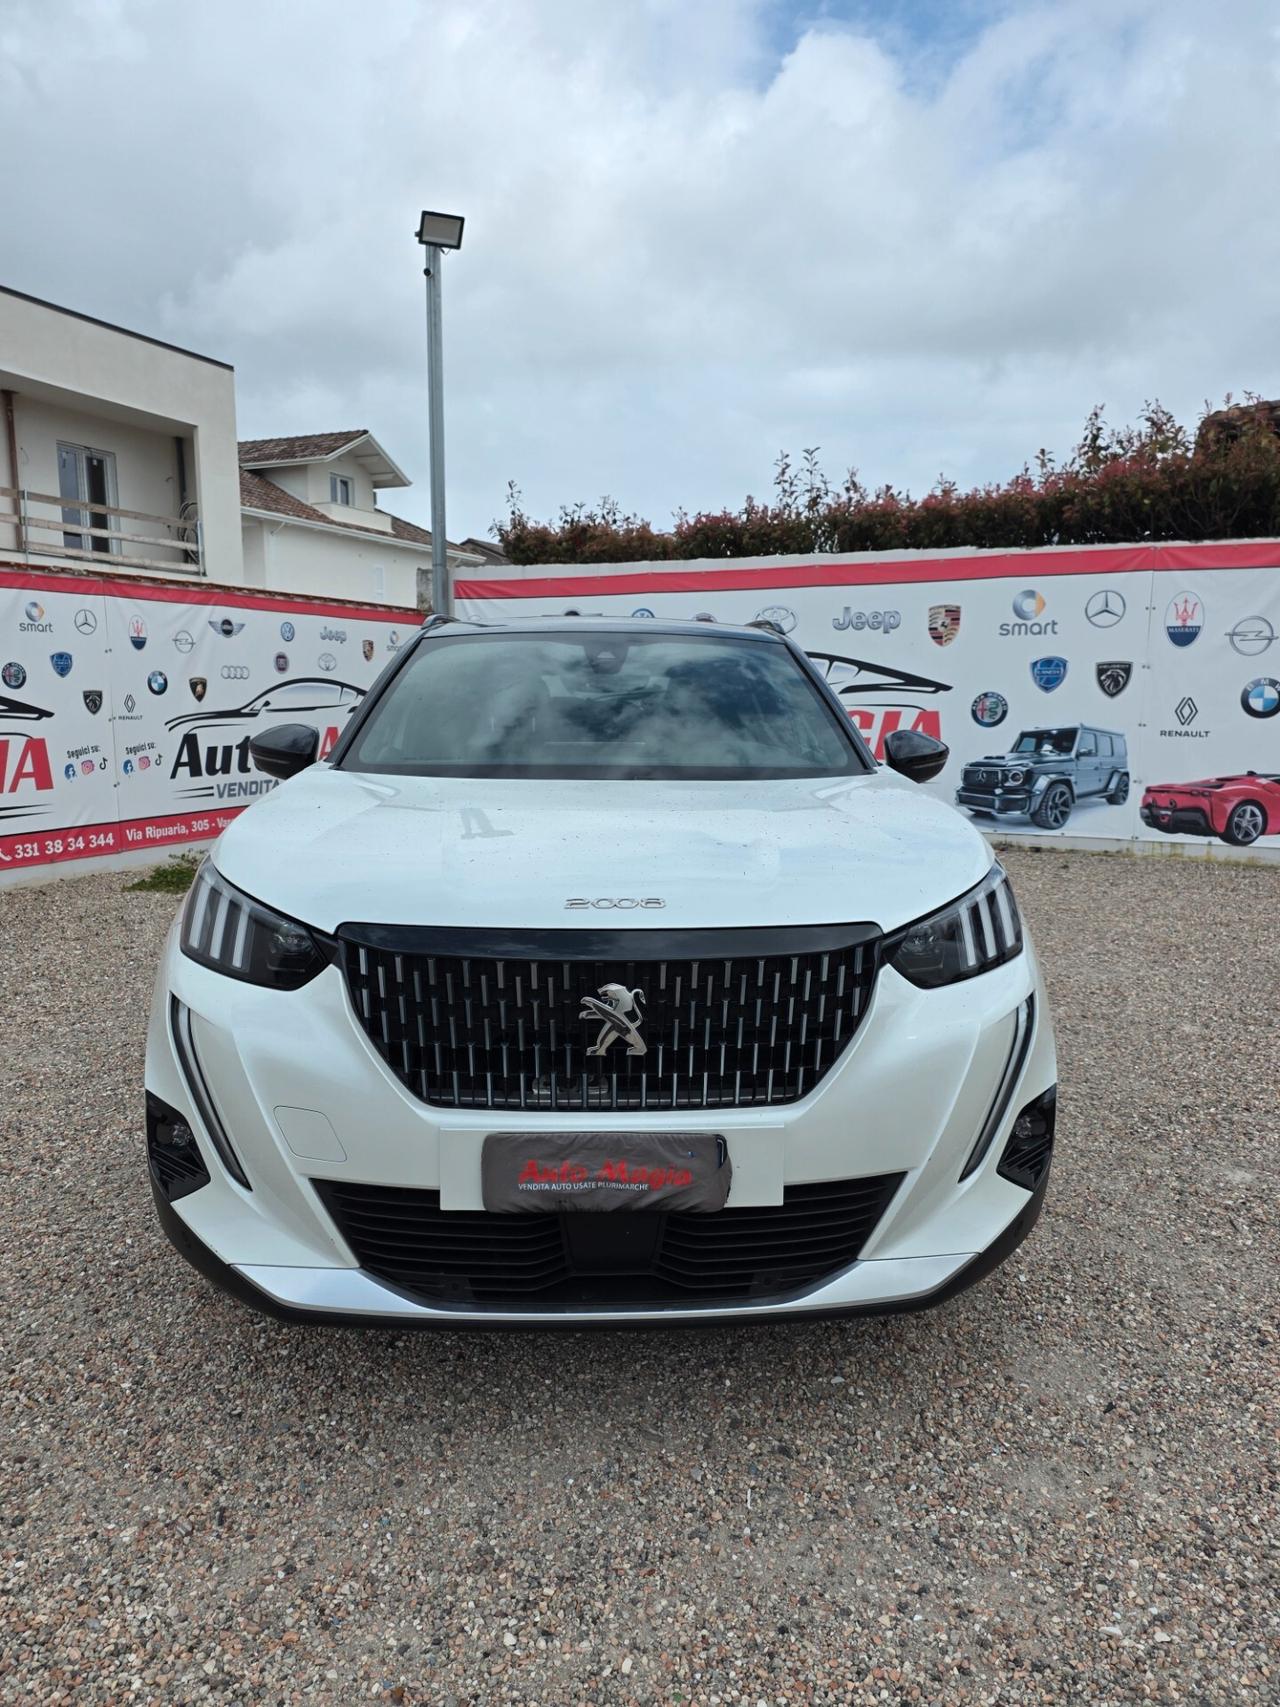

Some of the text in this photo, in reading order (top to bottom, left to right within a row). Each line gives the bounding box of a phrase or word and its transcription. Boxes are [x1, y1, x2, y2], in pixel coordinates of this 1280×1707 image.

[18, 621, 54, 633] smart
[832, 606, 901, 634] Jeep
[998, 619, 1058, 636] smart
[1160, 730, 1211, 738] RENAULT
[126, 829, 143, 841] Via
[145, 823, 189, 839] Ripuaria,
[191, 820, 209, 832] 305
[14, 832, 114, 859] 331 38 34 344
[564, 898, 666, 909] 2008
[518, 1159, 588, 1184] Auto
[518, 1181, 649, 1191] VENDITA AUTO USATE PLURIMARCHE
